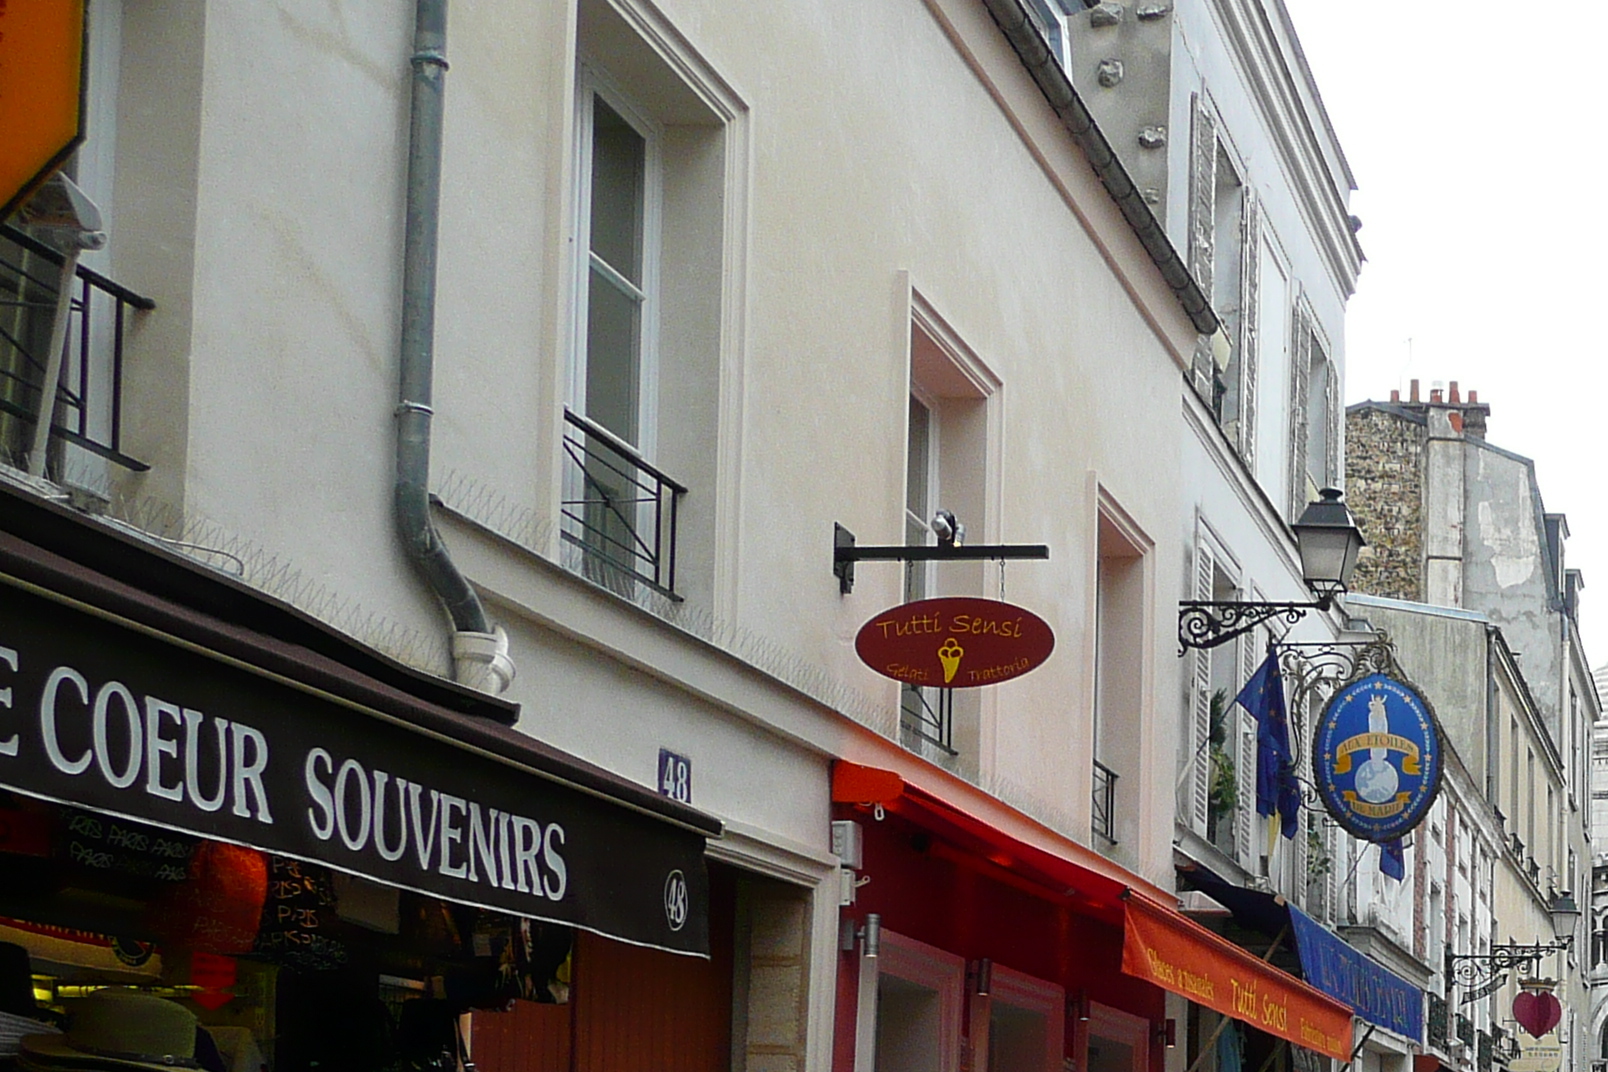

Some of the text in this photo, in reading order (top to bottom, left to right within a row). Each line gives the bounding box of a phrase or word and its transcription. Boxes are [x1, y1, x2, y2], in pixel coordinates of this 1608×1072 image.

[876, 611, 1023, 639] Tutti Sensi
[967, 656, 1030, 682] Trattoria
[41, 666, 274, 825] COEUR
[305, 747, 567, 901] SOUVENIRS
[664, 756, 688, 803] 48
[668, 878, 685, 924] 48
[1230, 977, 1258, 1020] Tutti
[1261, 994, 1288, 1032] Sensi
